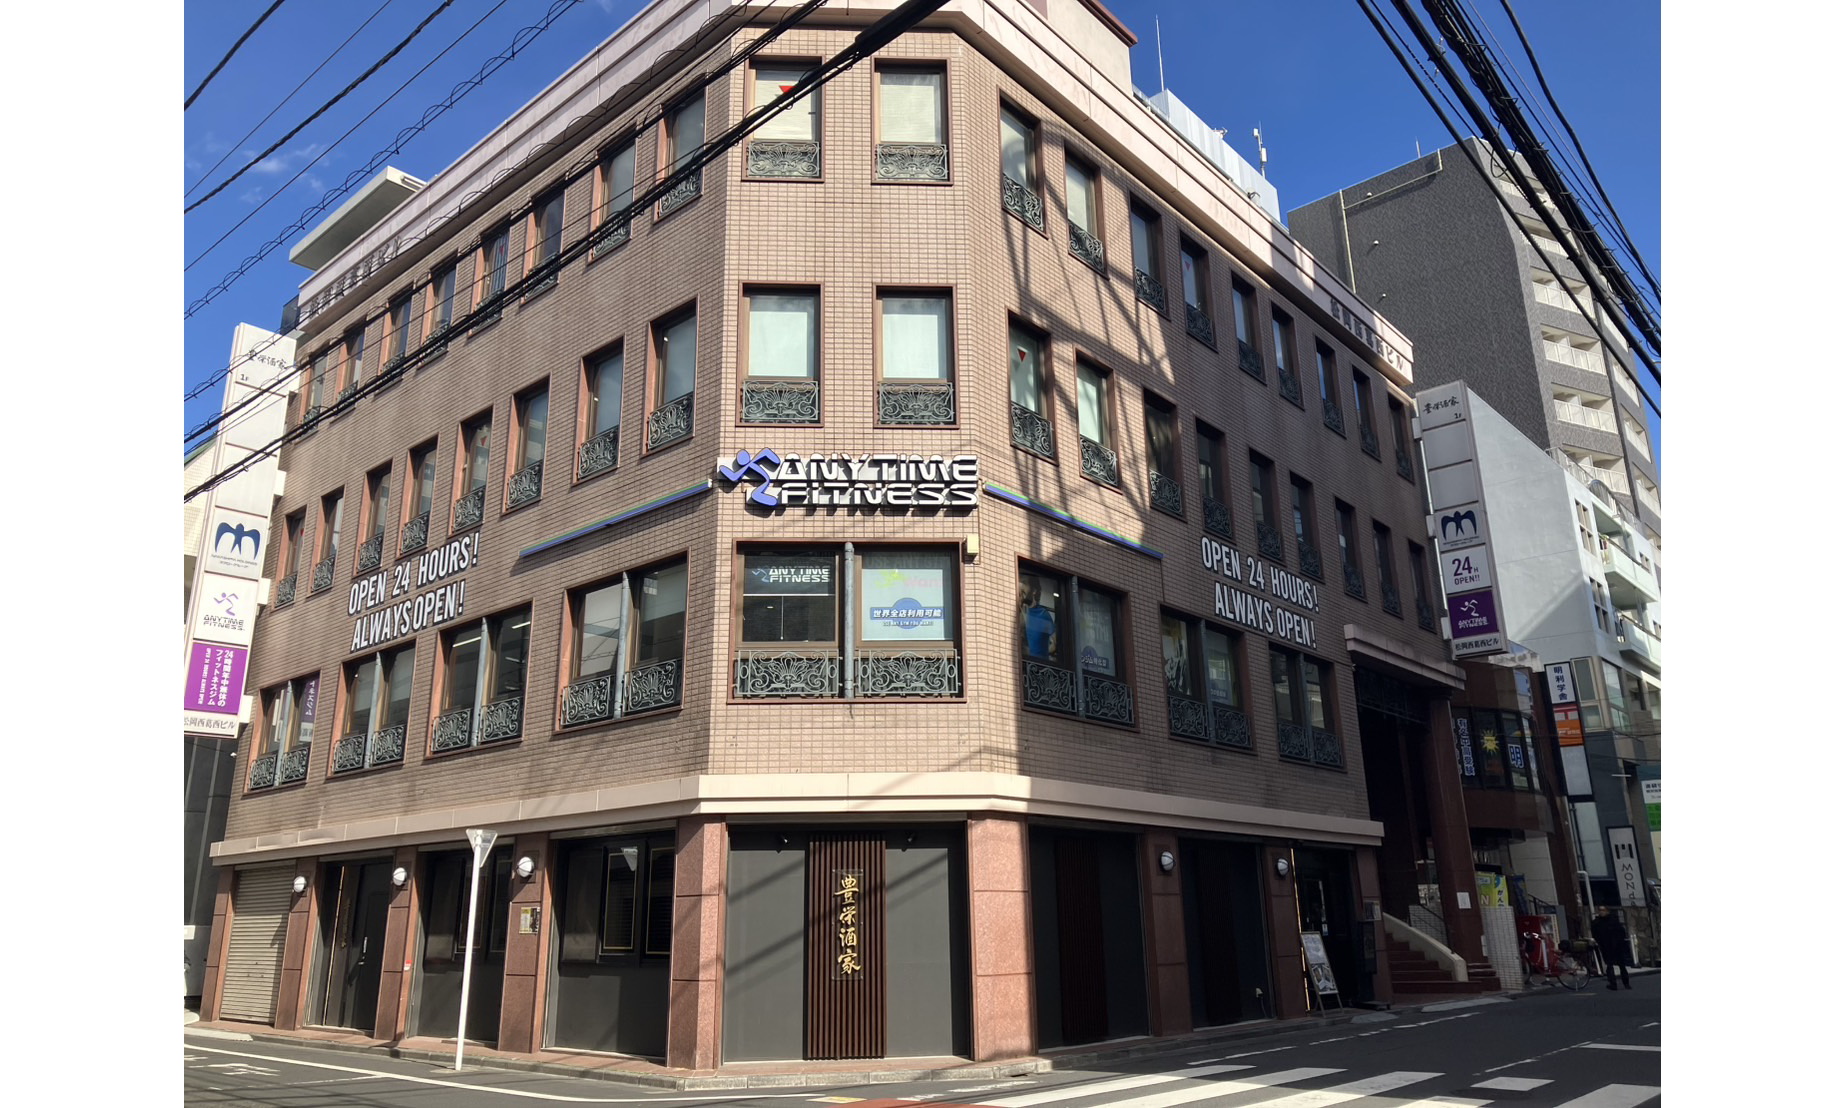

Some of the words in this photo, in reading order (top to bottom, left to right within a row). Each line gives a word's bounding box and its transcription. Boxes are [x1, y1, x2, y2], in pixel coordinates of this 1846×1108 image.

[776, 453, 978, 480] ANYTIME
[780, 482, 978, 506] FITNESS
[348, 570, 388, 615] OPEN
[392, 561, 411, 596] 24
[417, 532, 479, 586] HOURS!
[768, 566, 831, 575] ANYTIME
[769, 575, 830, 583] FITNESS
[1201, 536, 1242, 581] OPEN
[1247, 556, 1265, 590] 24
[1270, 566, 1319, 612] HOURS!
[203, 614, 244, 625] ANYTIME
[203, 621, 244, 631] FITNESS
[351, 600, 412, 651] ALWAYS
[412, 580, 465, 631] OPEN!
[873, 609, 943, 618] 世界全店利用可能
[1215, 582, 1274, 634] ALWAYS
[1276, 607, 1317, 649] OPEN!
[207, 649, 224, 706] フィットネスジム
[217, 649, 234, 707] 24時間年中無休の
[834, 874, 862, 975] 豊栄酒家
